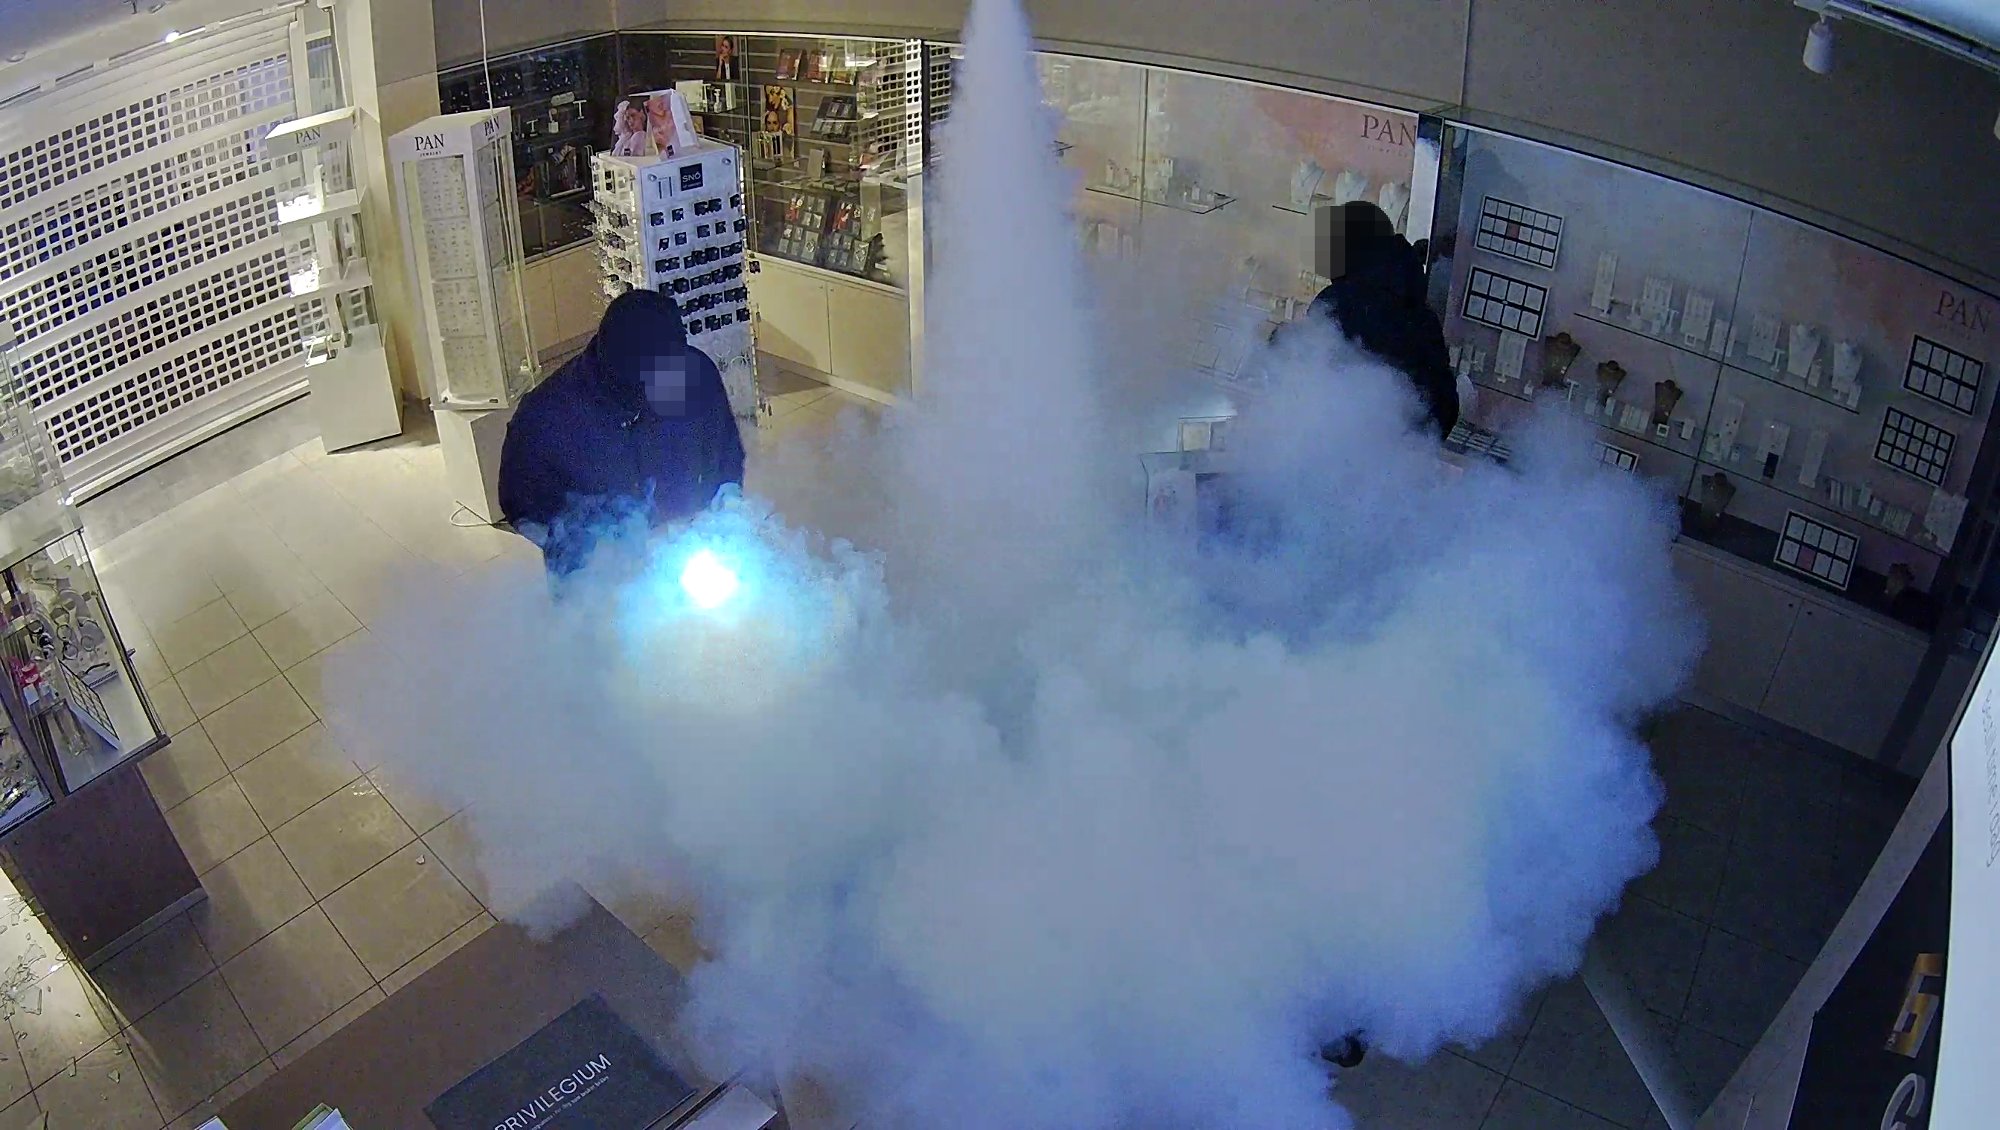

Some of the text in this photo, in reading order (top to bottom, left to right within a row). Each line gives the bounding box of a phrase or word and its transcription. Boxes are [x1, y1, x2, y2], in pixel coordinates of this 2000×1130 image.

[295, 127, 321, 144] PAN
[484, 116, 500, 137] PAN
[1361, 114, 1417, 148] PAN
[414, 133, 445, 151] PAN
[1933, 290, 1991, 335] PAN
